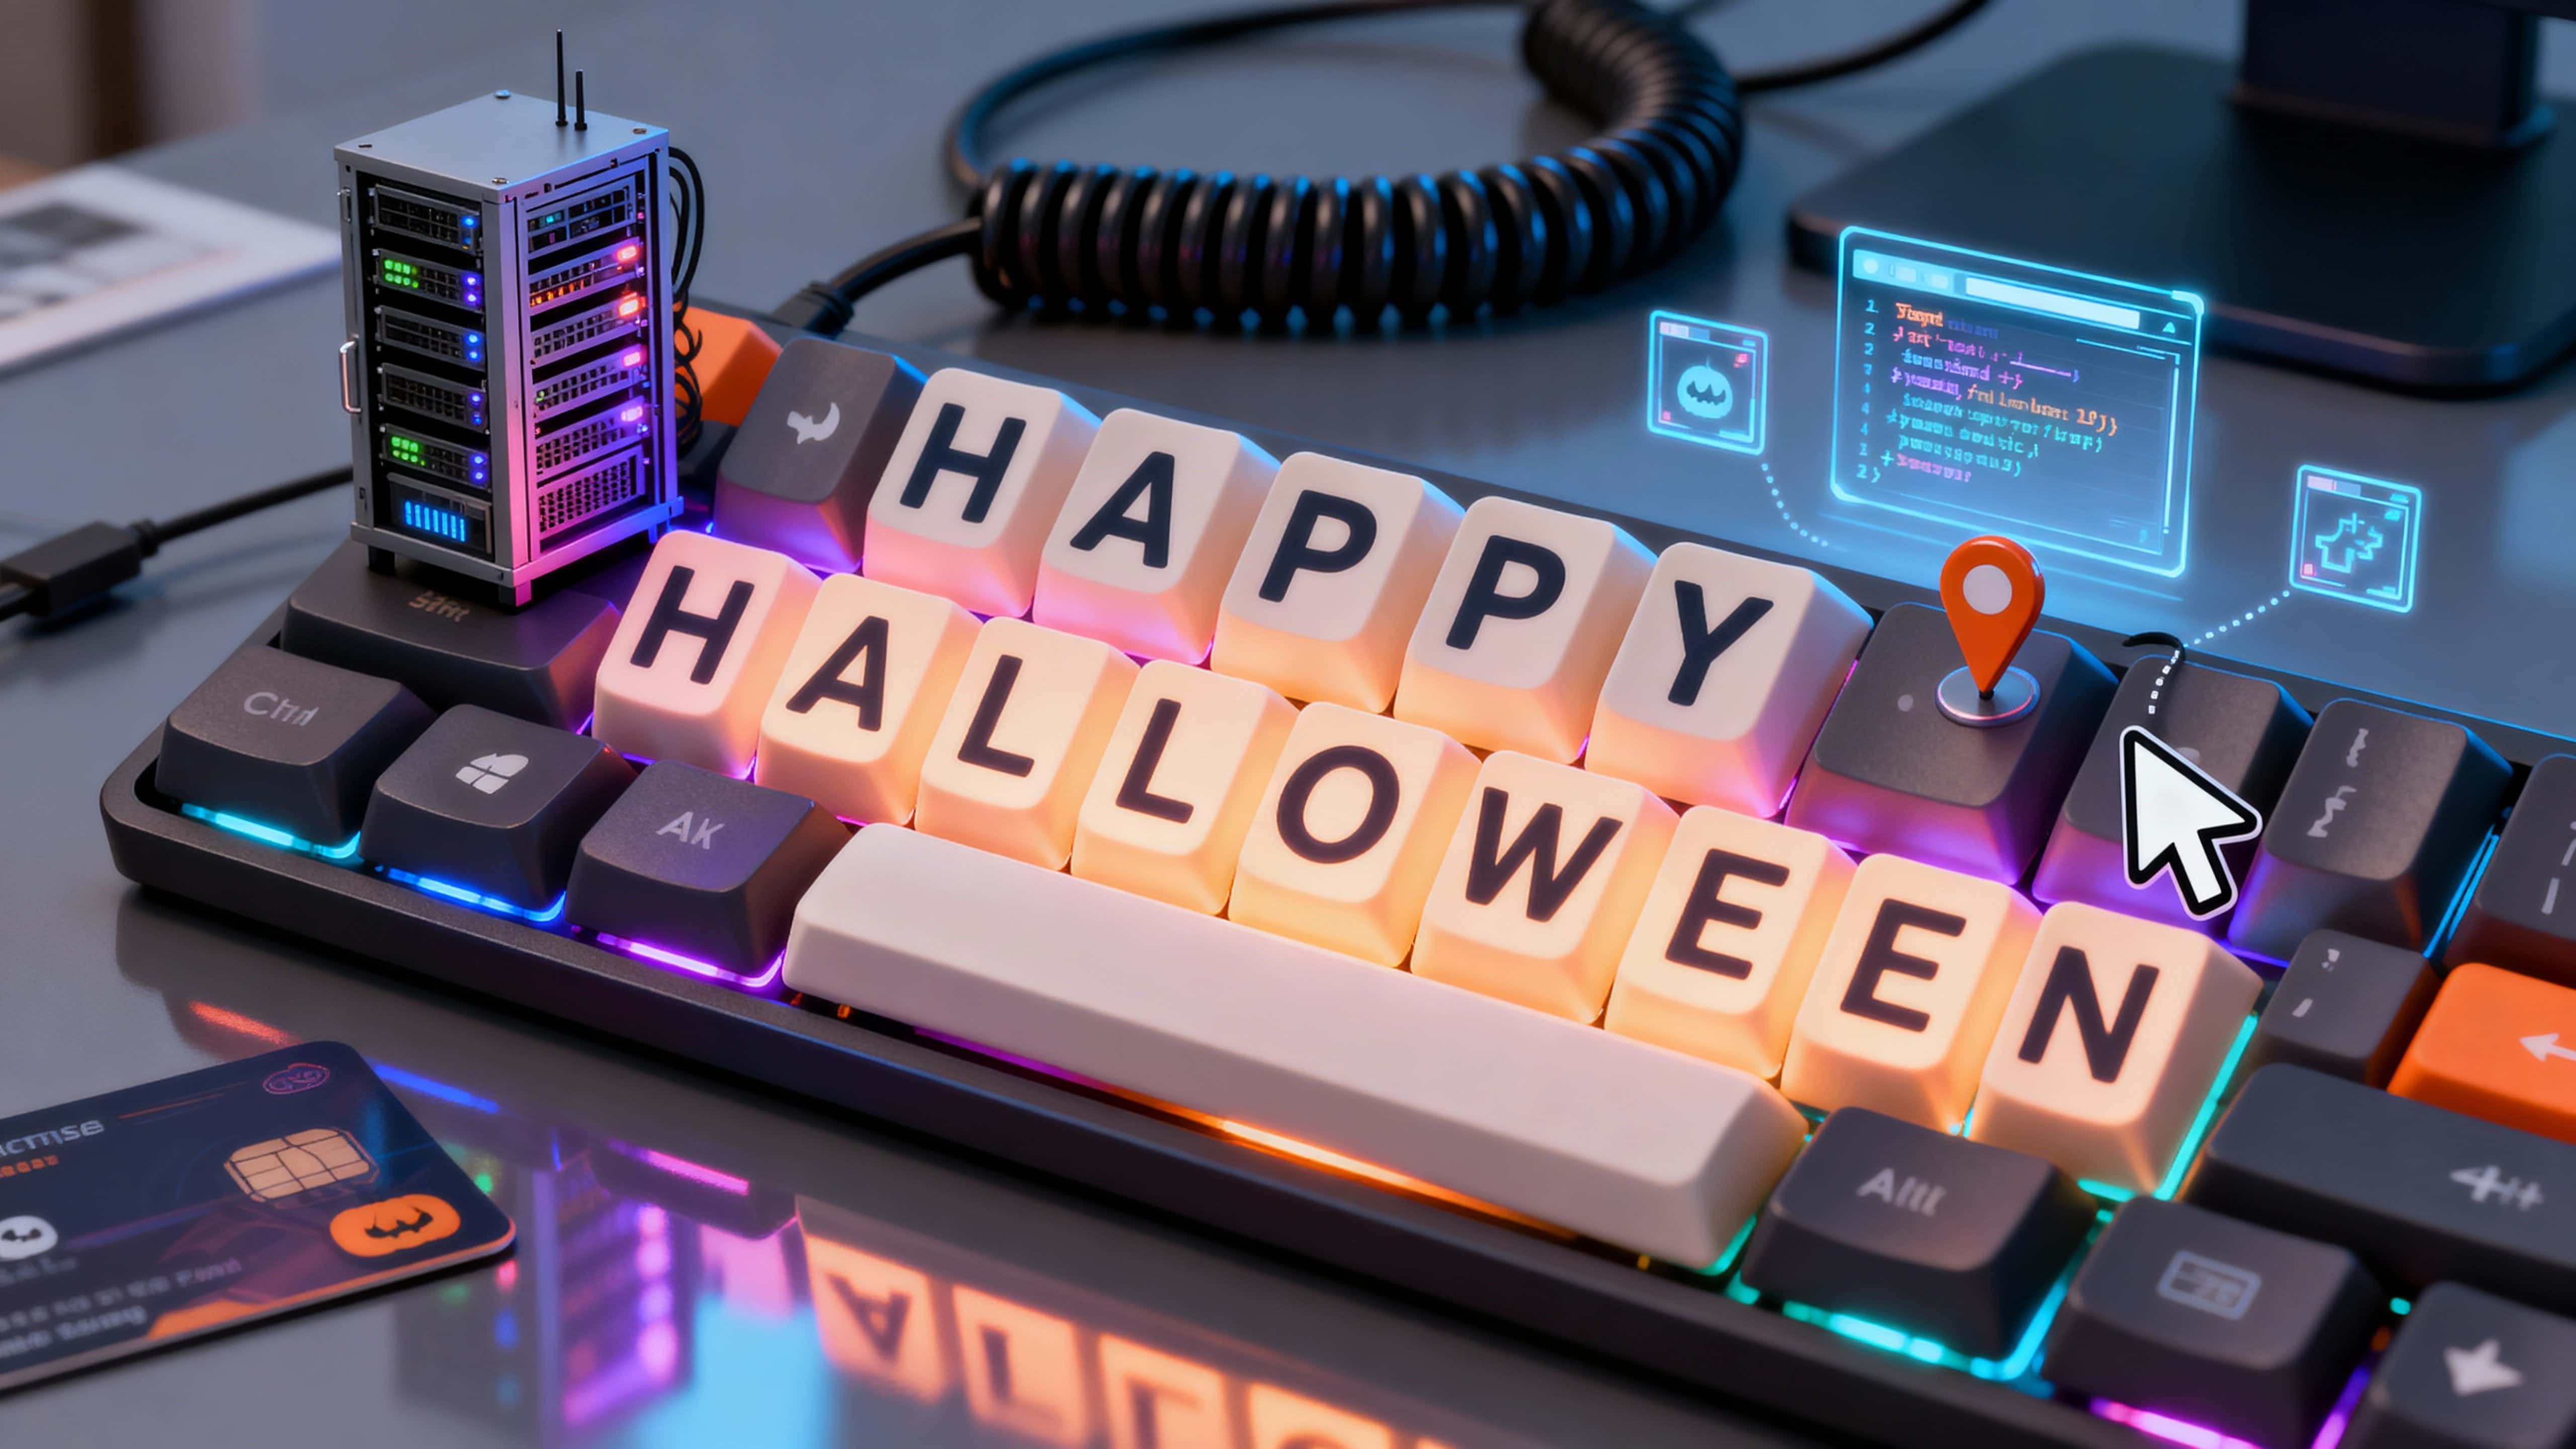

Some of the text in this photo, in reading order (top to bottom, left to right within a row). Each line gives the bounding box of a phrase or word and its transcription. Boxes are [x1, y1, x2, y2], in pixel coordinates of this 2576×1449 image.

[1864, 321, 1876, 336] 2
[1864, 342, 1875, 356] 2
[899, 401, 1775, 707] HAPPY
[629, 564, 2159, 1082] HALLOWEEN
